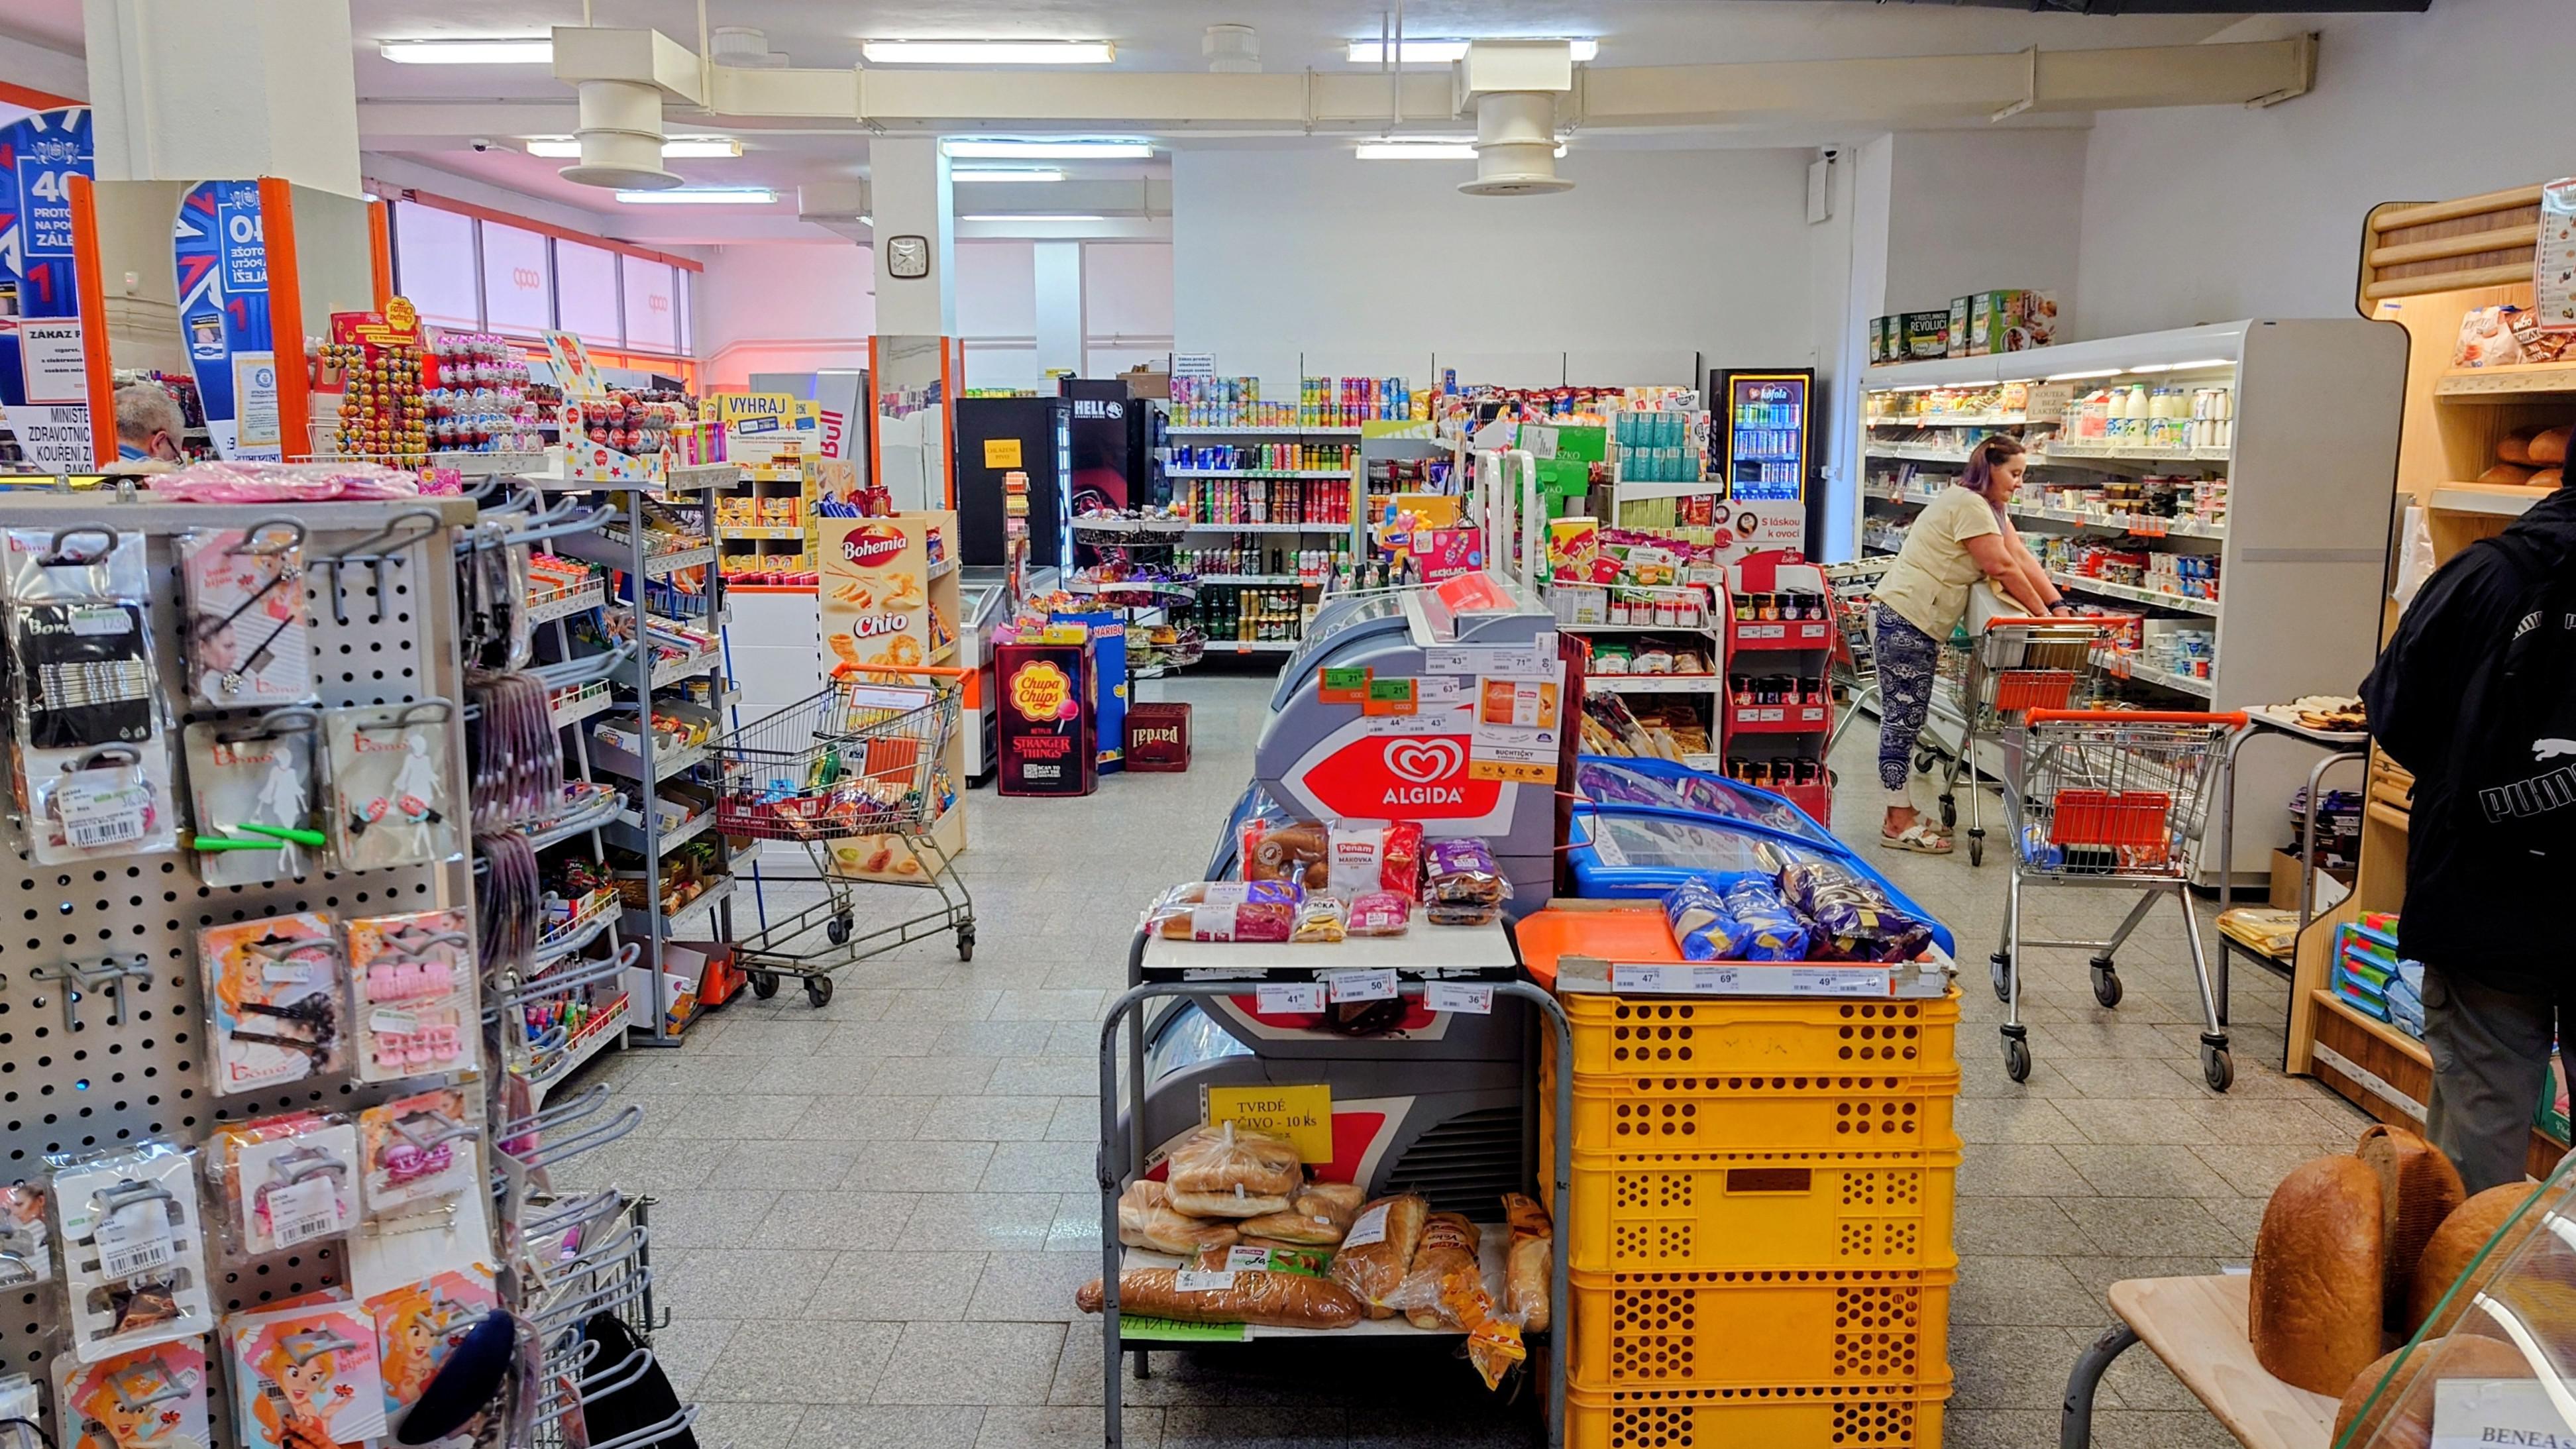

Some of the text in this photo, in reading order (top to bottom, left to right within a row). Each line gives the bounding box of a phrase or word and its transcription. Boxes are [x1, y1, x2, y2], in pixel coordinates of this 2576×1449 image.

[35, 221, 52, 230] NA
[1910, 319, 1947, 332] REVOLUCI
[30, 329, 72, 339] ZÁKAZ
[1760, 388, 1787, 402] kofola
[729, 398, 785, 413] VYHRAJ
[1074, 400, 1106, 415] HELL
[820, 410, 843, 458] Bull
[36, 443, 80, 462] KOUŘENÍ
[1770, 517, 1800, 526] láskou
[841, 535, 907, 561] Bohemia
[854, 612, 908, 637] Chio
[1094, 623, 1124, 638] HARIBO
[1021, 677, 1060, 694] Chupa
[1020, 690, 1059, 710] Chups
[1013, 737, 1071, 753] STRANGER
[1021, 749, 1062, 759] THINGS
[1495, 749, 1534, 758] BUCHTIČKY
[1383, 786, 1463, 805] ALGIDA
[2479, 763, 2576, 823] PUM
[1338, 843, 1372, 853] Penam
[1721, 975, 1731, 983] 69
[1468, 995, 1479, 1004] 36
[1237, 1099, 1287, 1113] TVRDÉ
[1287, 1116, 1300, 1127] 10
[1304, 1112, 1317, 1127] ks
[2481, 1426, 2558, 1449] BENEA
